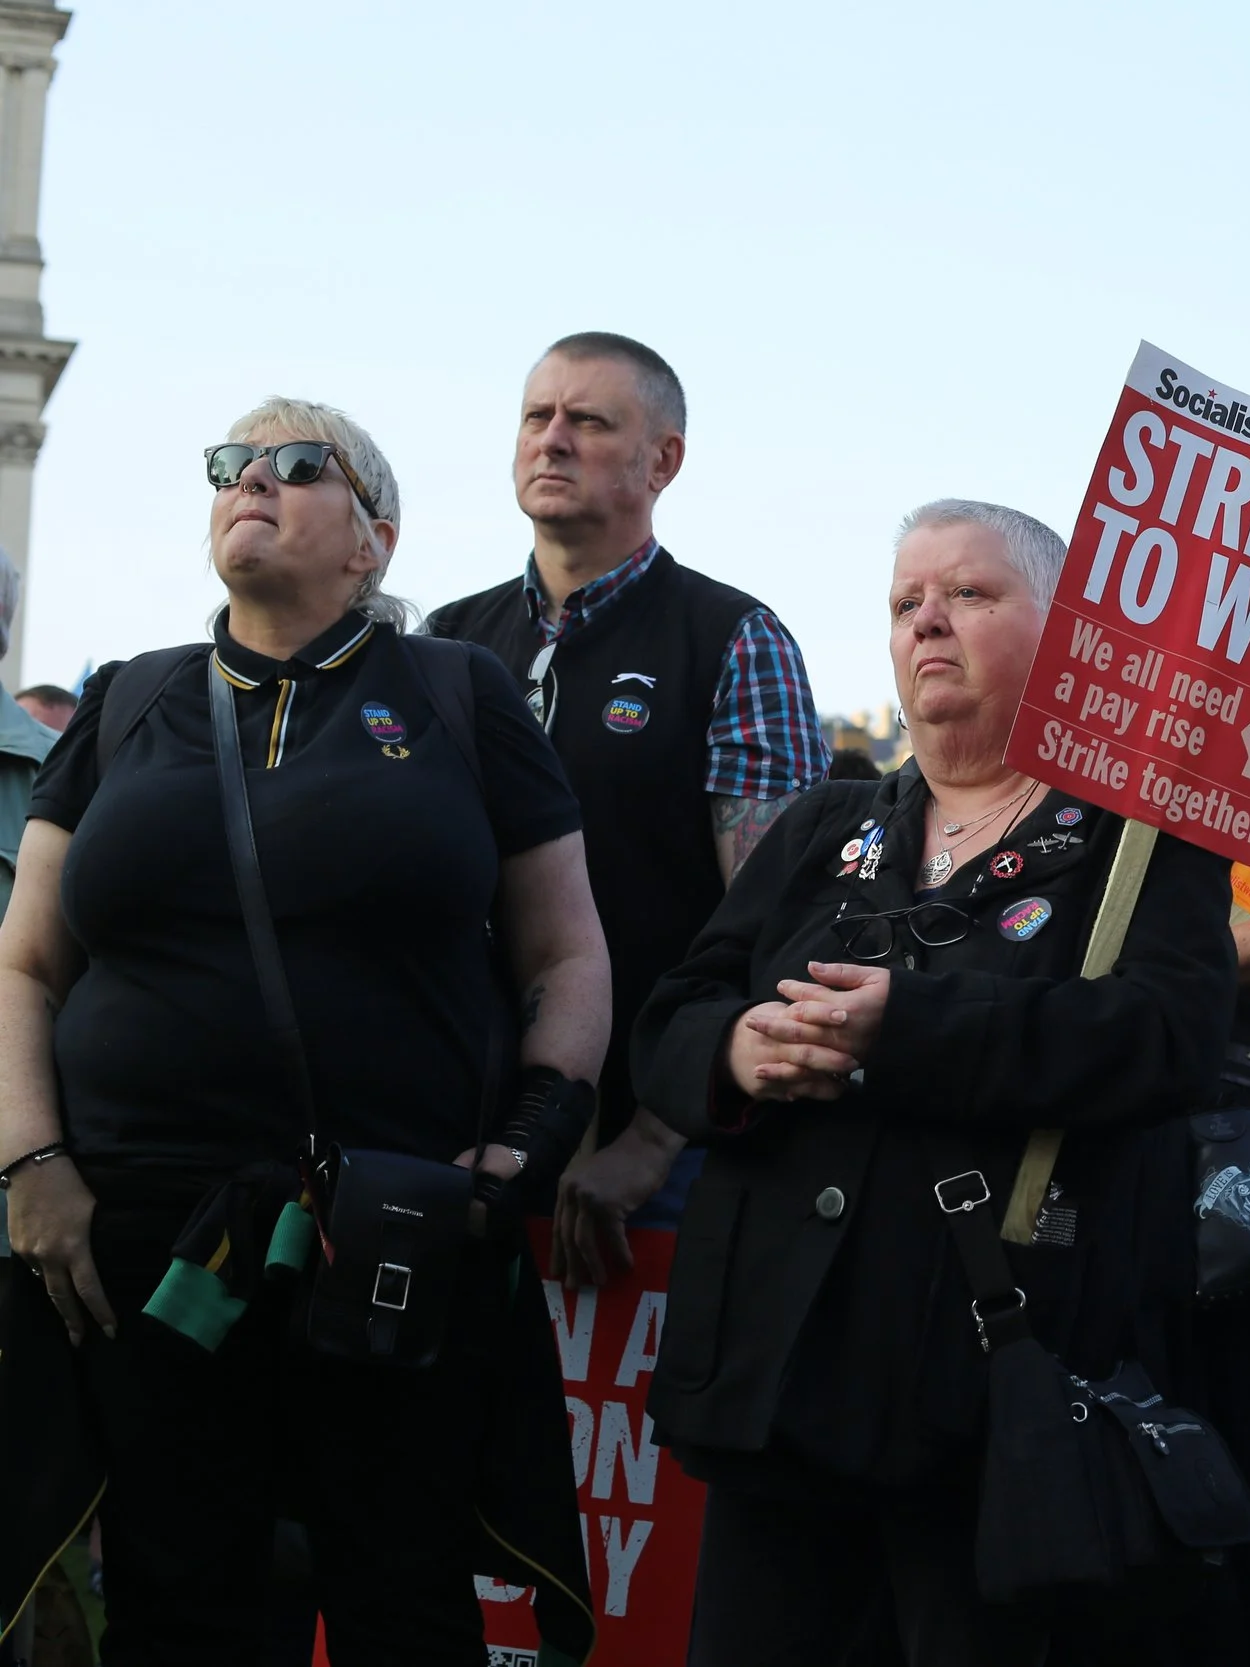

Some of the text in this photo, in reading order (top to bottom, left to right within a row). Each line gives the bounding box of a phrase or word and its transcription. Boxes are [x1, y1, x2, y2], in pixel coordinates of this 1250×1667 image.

[1083, 502, 1178, 625] TO
[1069, 618, 1243, 725] We all need
[364, 709, 390, 718] STAND
[610, 707, 638, 718] UP TO
[612, 700, 642, 712] STAND
[1055, 672, 1205, 755] a pay rise
[367, 718, 379, 726] UP
[608, 713, 641, 727] RACISM
[1038, 720, 1128, 790] Strike
[1030, 907, 1044, 920] UP
[1013, 919, 1030, 931] TO
[1017, 911, 1049, 937] STAND
[1206, 1169, 1234, 1200] LOVE IS
[579, 1512, 654, 1617] Y
